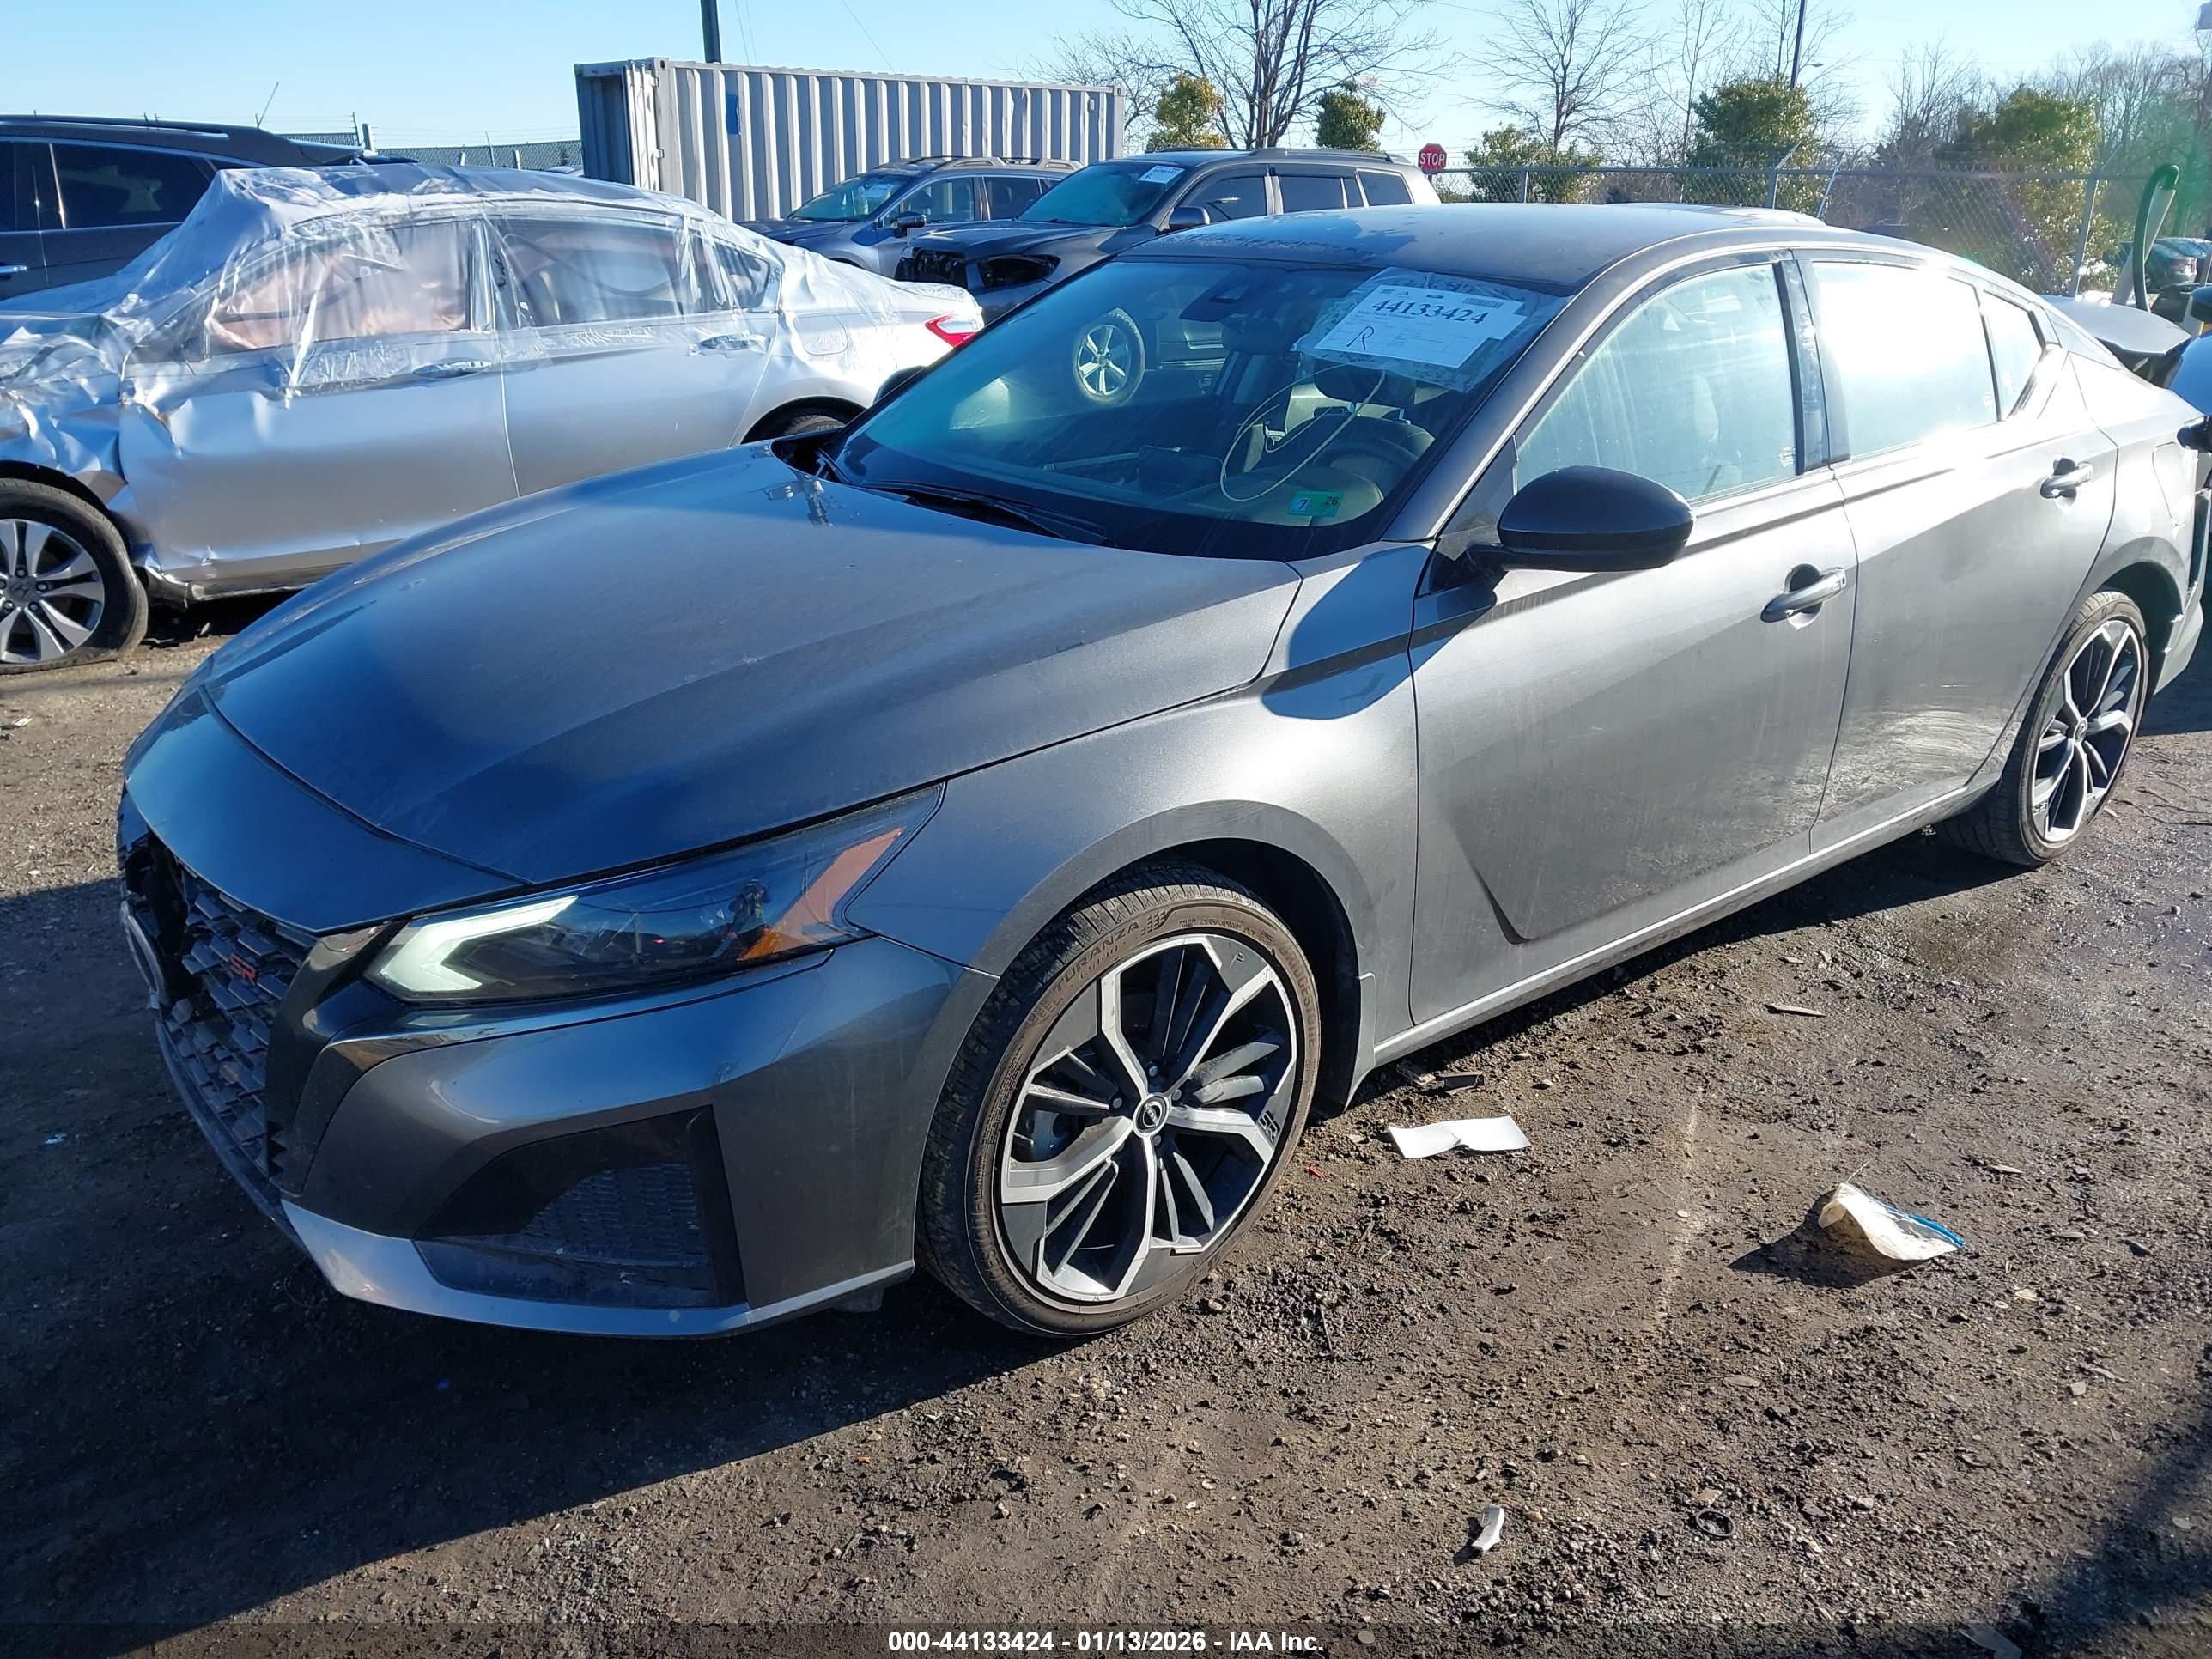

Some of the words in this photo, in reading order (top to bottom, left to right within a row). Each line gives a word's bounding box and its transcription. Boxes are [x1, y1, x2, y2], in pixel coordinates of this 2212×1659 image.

[1419, 152, 1445, 166] STOP
[1372, 299, 1490, 325] 44133424
[1346, 325, 1375, 351] R
[1325, 495, 1340, 507] 26
[229, 953, 257, 987] SR
[1052, 921, 1140, 993] TURANZA
[1258, 1109, 1281, 1142] SR
